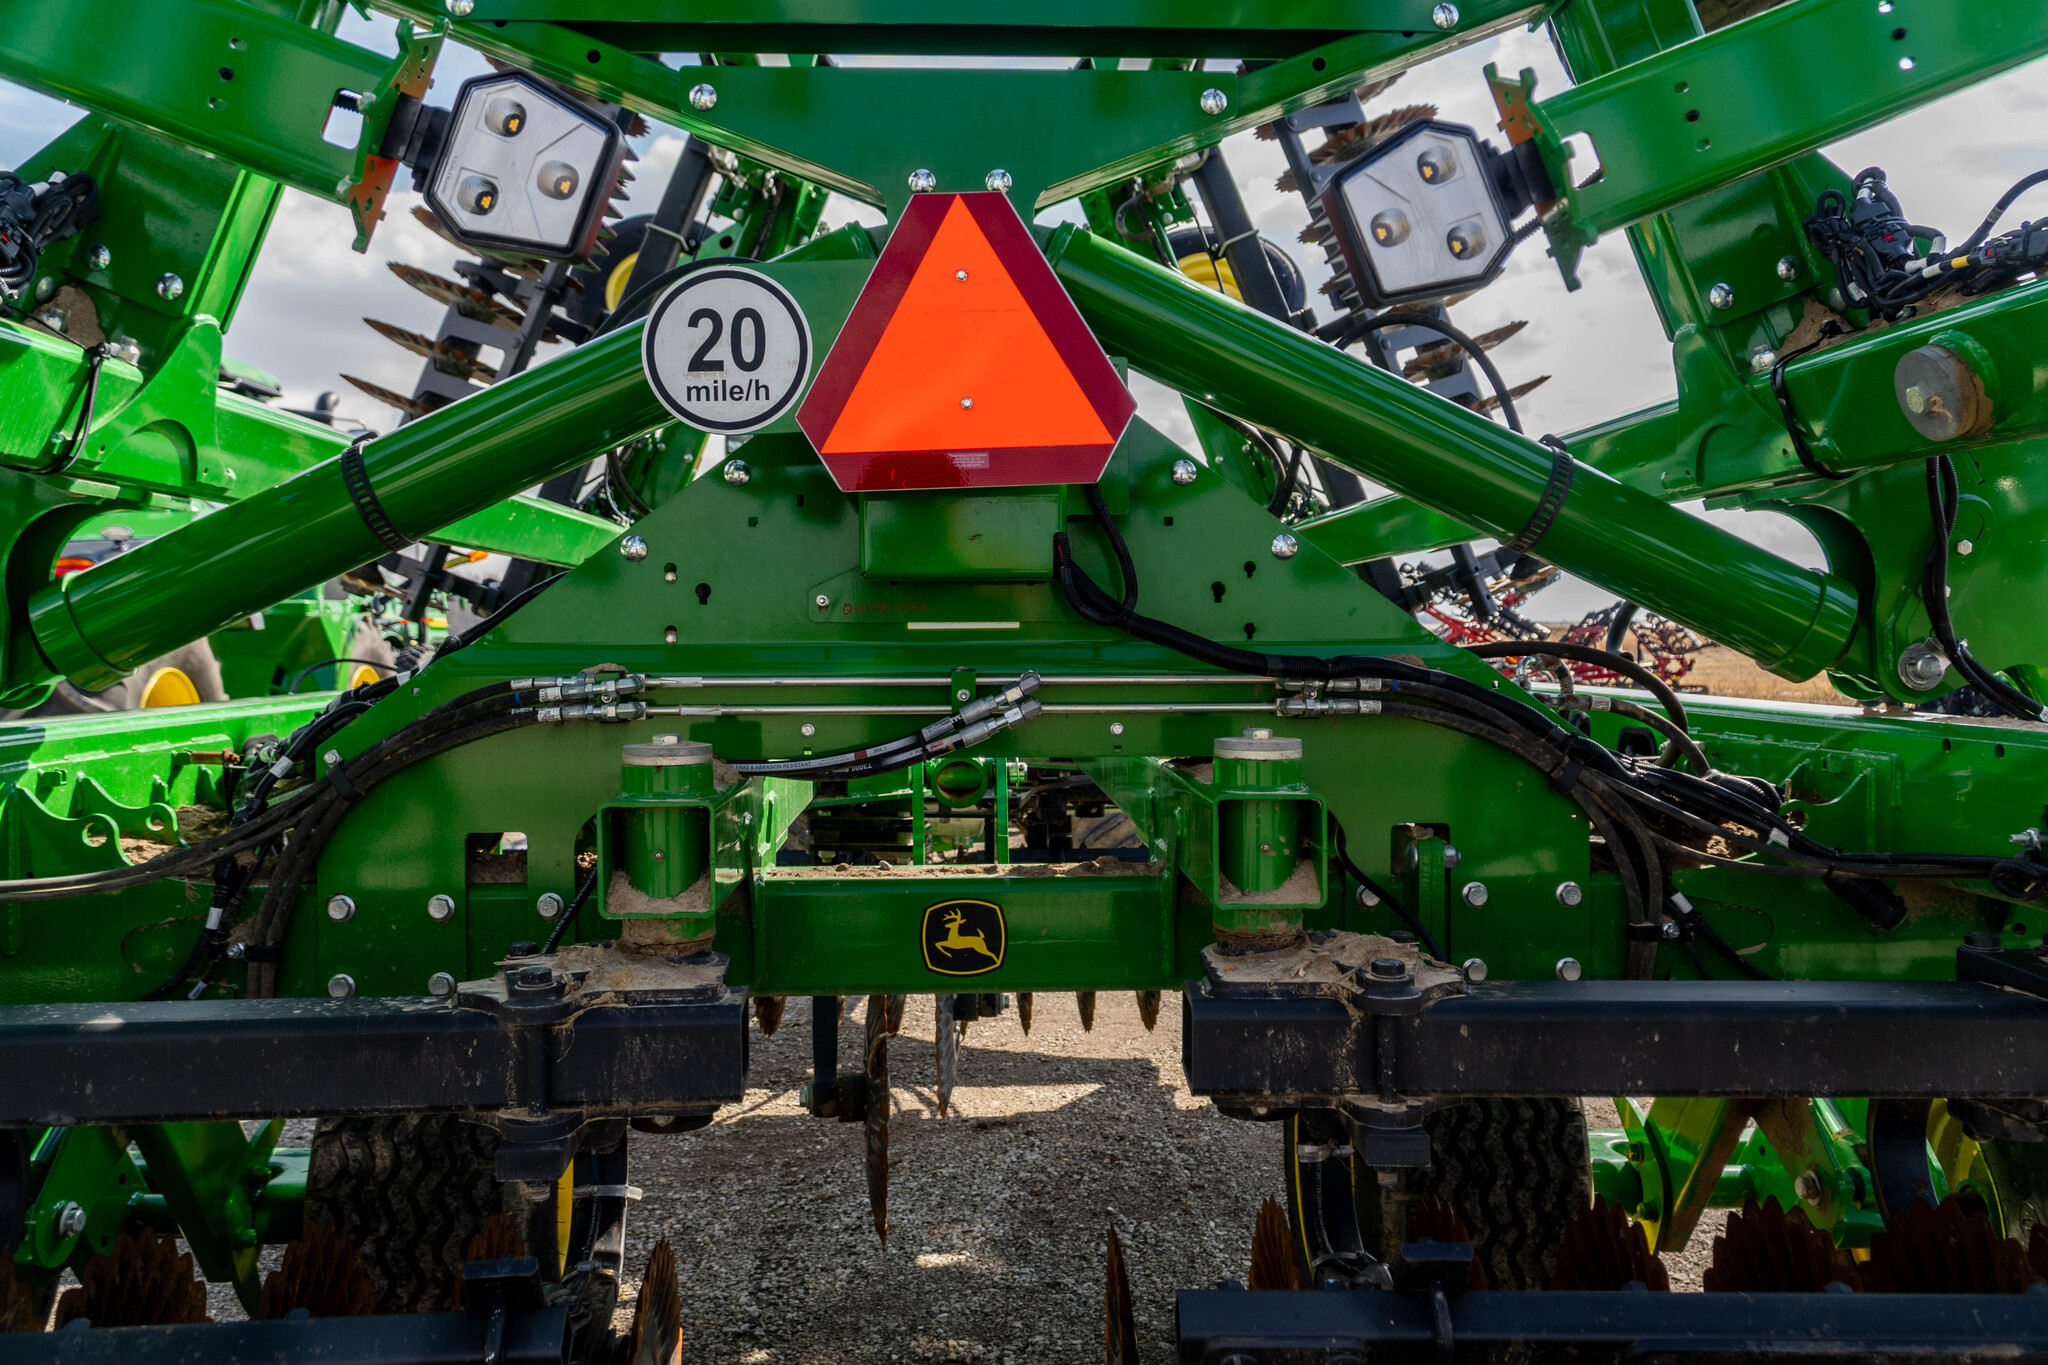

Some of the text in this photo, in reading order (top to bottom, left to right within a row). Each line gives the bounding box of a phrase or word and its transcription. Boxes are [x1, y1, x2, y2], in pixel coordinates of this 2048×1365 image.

[688, 307, 766, 372] 20
[686, 379, 770, 402] mile/h
[755, 763, 782, 771] ABRASION
[782, 761, 812, 770] RESISTANT
